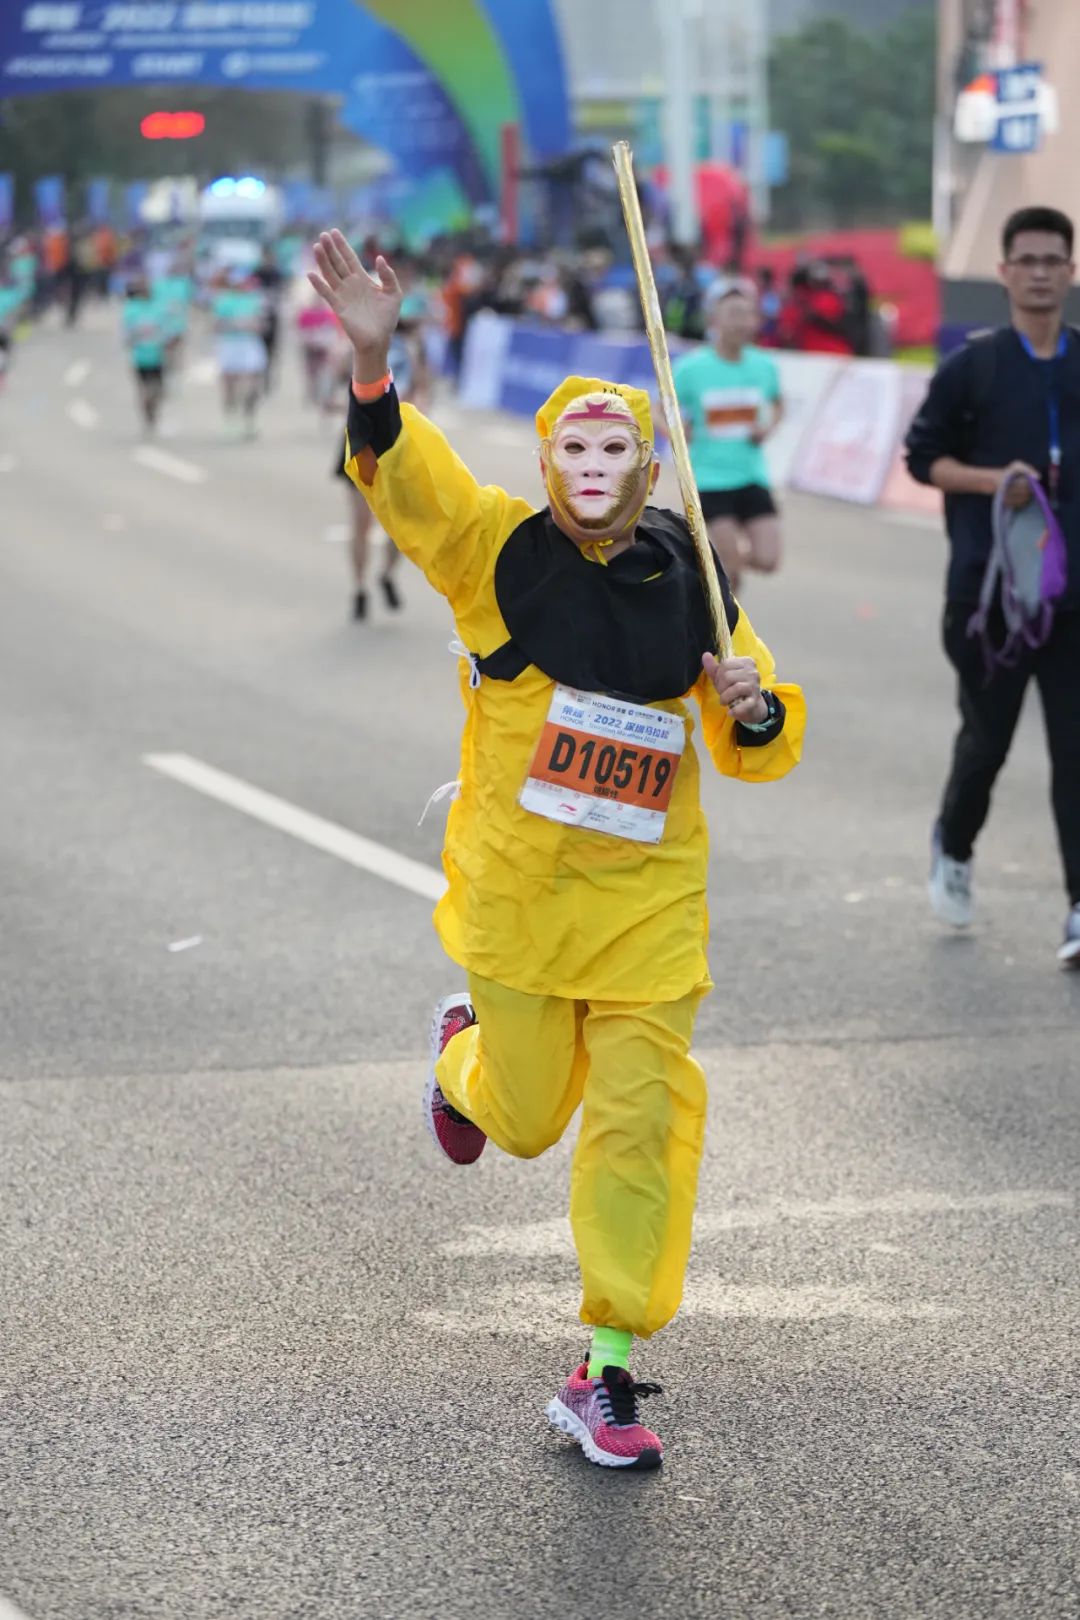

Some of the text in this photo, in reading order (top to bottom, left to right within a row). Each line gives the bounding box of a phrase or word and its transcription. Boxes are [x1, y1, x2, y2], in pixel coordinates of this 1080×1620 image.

[592, 701, 616, 711] HONOR
[594, 714, 622, 729] 2022
[548, 732, 671, 797] D10519
